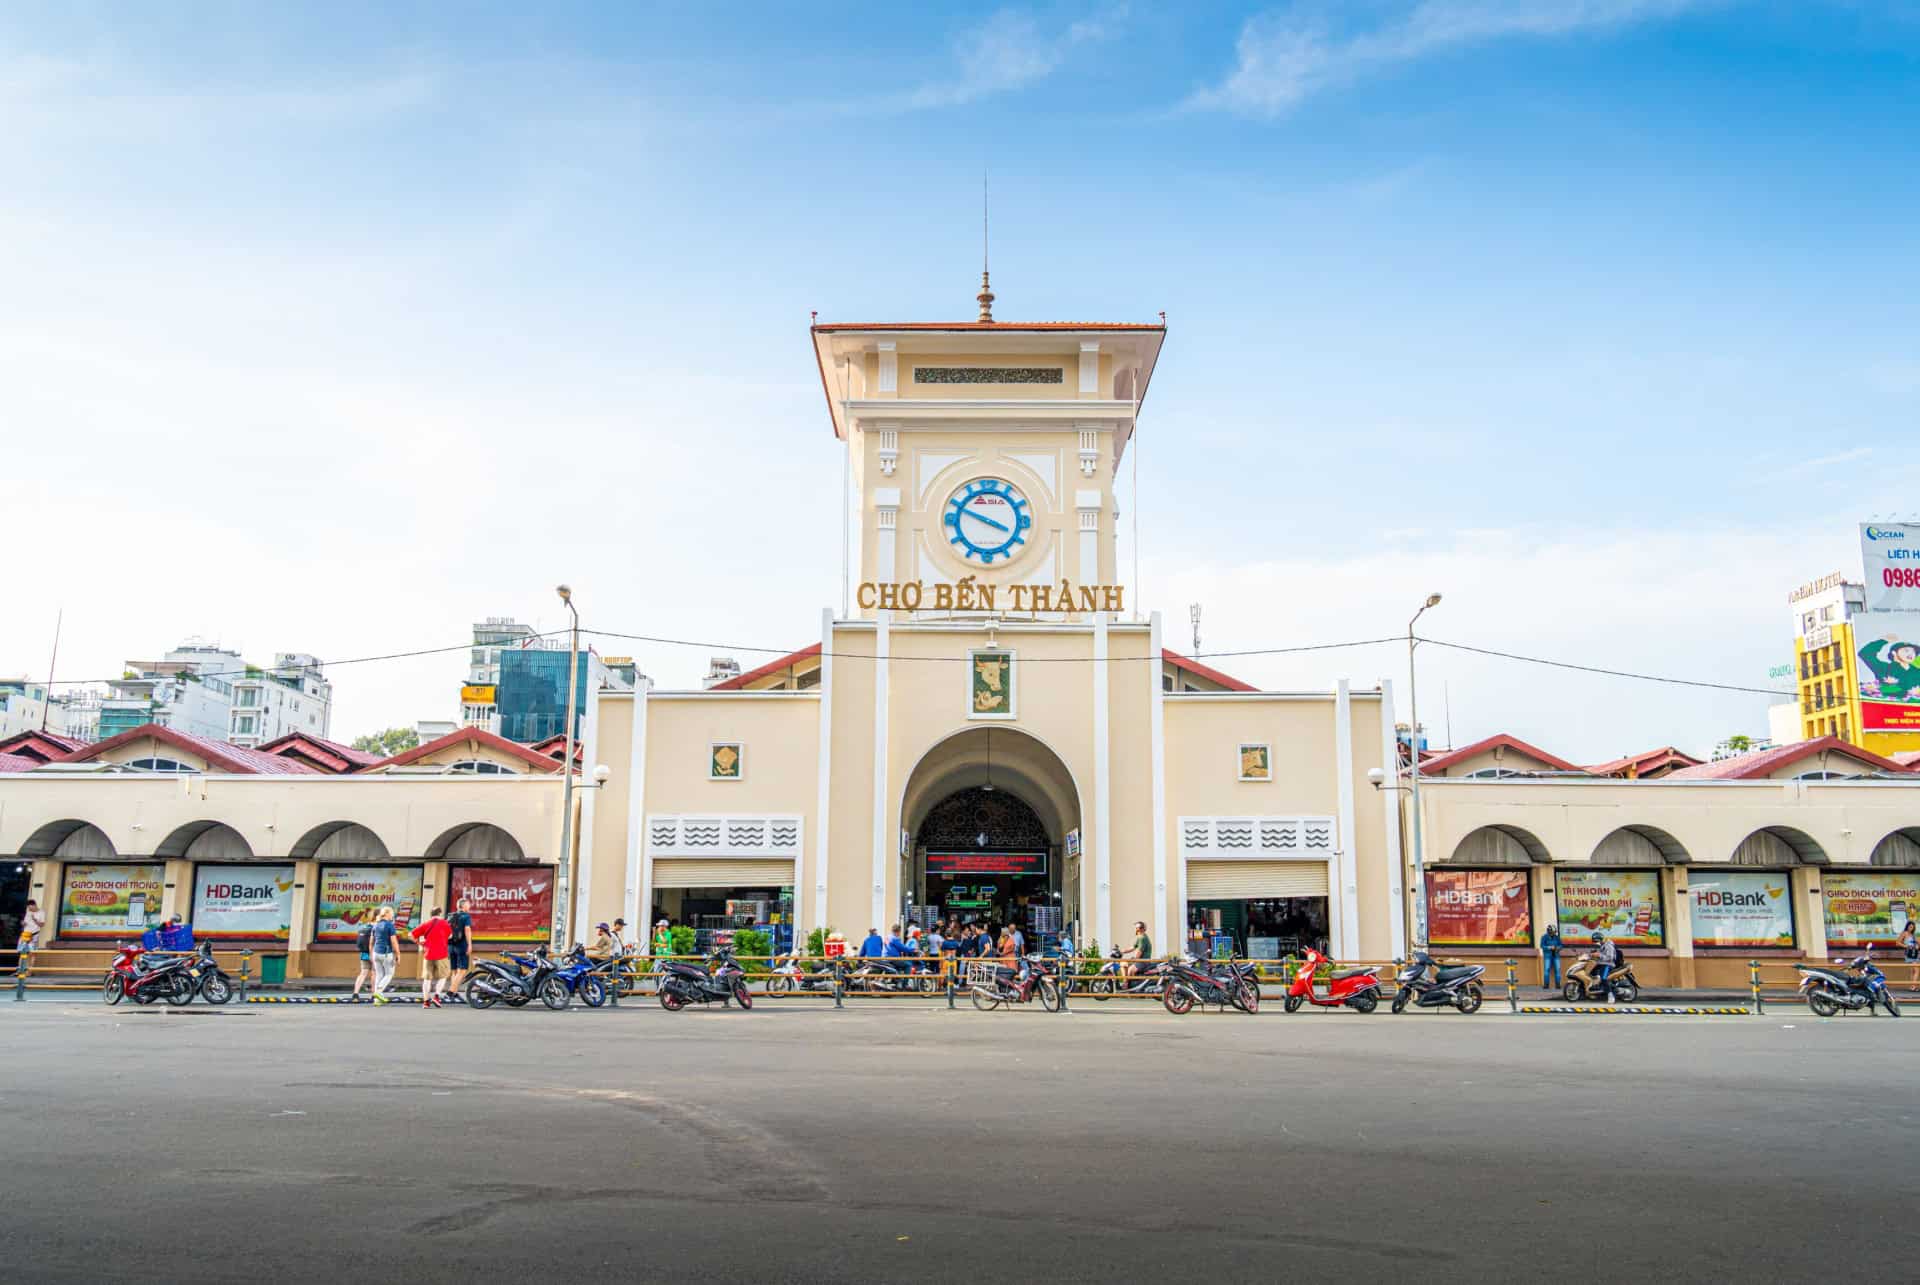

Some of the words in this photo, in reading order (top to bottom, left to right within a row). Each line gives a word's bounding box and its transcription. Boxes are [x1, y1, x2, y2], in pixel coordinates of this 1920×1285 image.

[857, 579, 922, 613] CHỢ
[934, 575, 997, 610] BẾN
[1008, 578, 1125, 612] THÀNH
[206, 884, 274, 899] HDBank
[463, 886, 528, 900] HDBank
[1436, 890, 1504, 905] HDBank
[1697, 891, 1766, 906] HDBank
